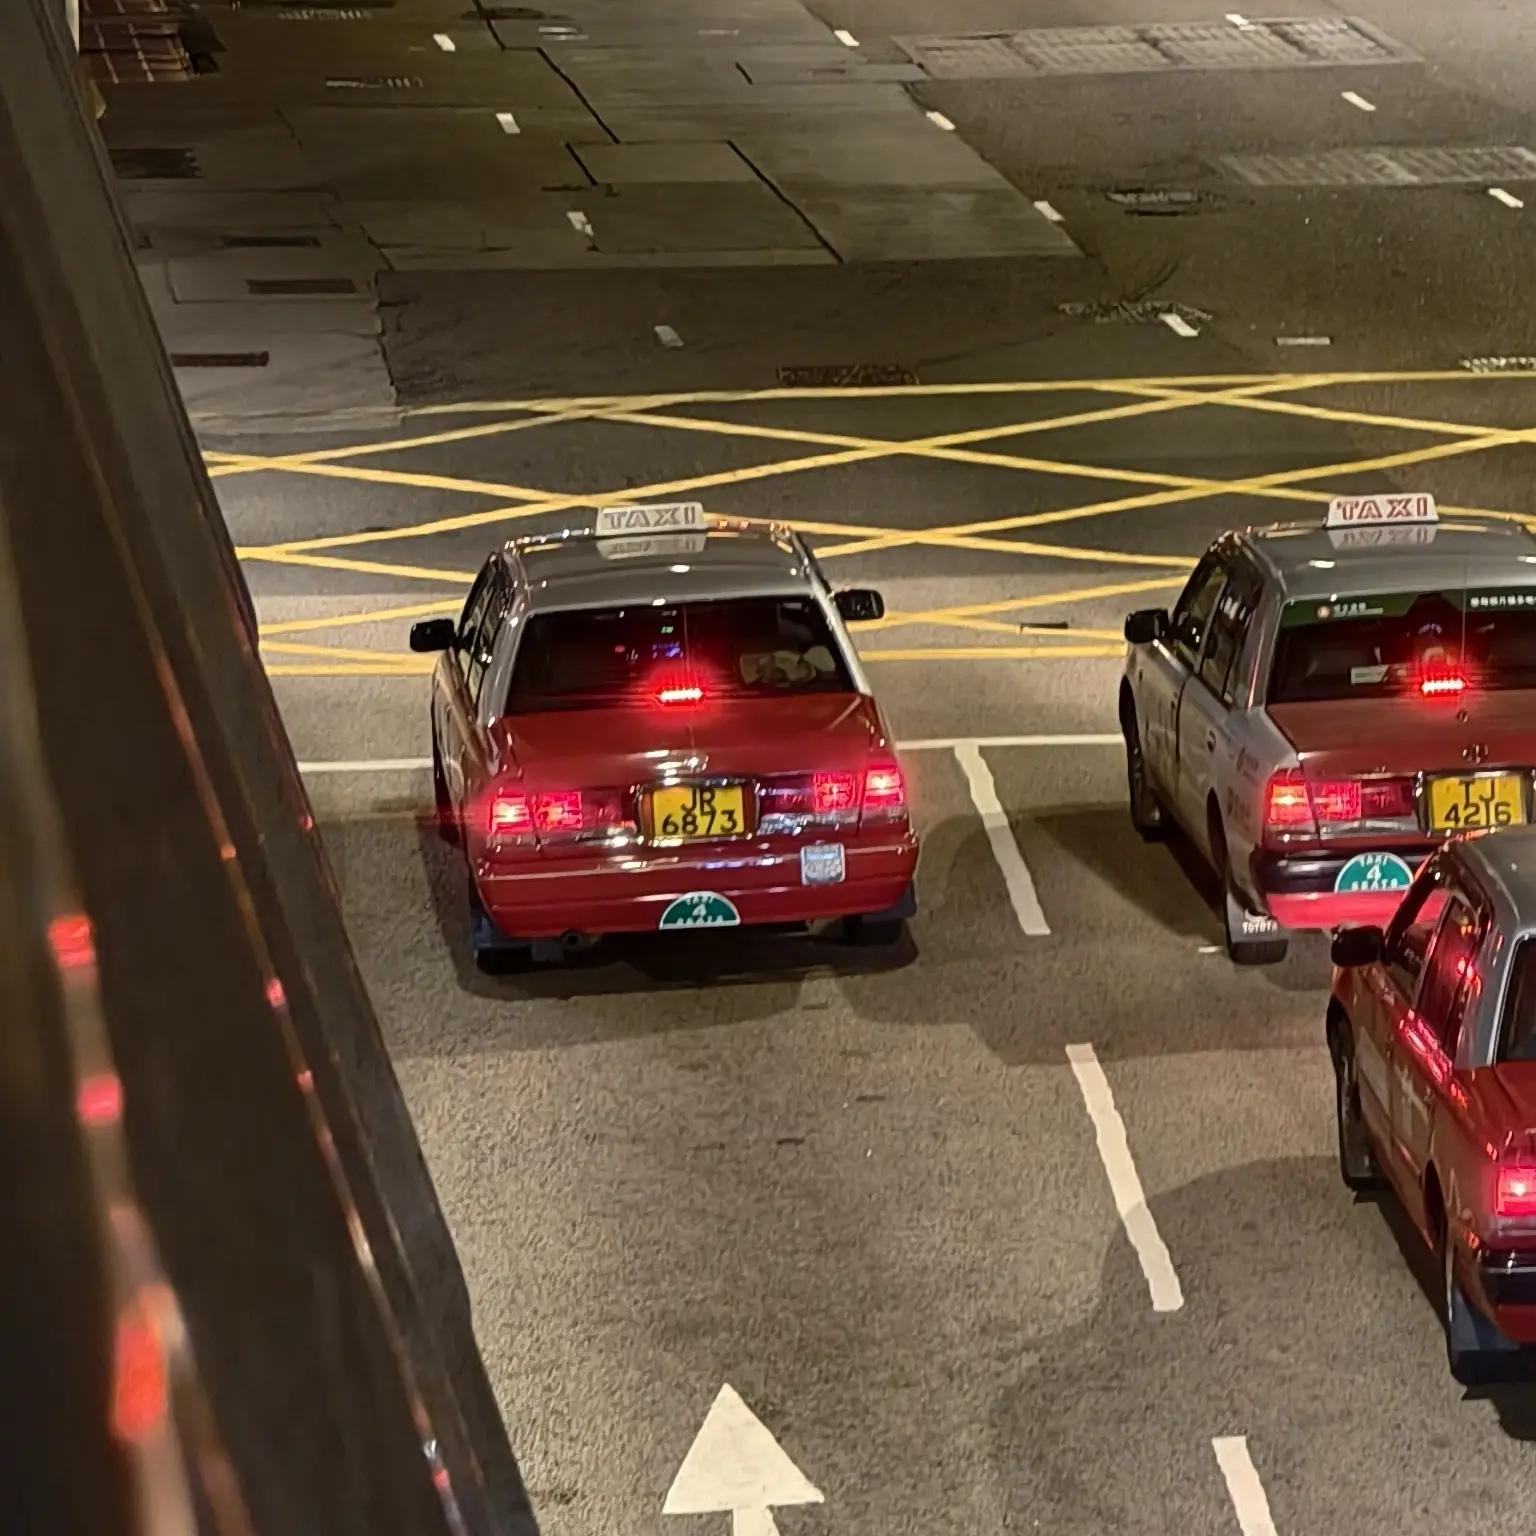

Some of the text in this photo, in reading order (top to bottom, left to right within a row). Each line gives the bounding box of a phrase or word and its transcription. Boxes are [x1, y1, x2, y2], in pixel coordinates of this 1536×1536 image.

[603, 506, 696, 530] TAXI
[1337, 497, 1429, 521] TAXI
[681, 787, 716, 815] JR
[1459, 778, 1496, 809] TJ
[662, 809, 738, 836] 6873
[1444, 802, 1512, 827] 4216
[1366, 865, 1382, 880] 4
[692, 904, 707, 918] 4
